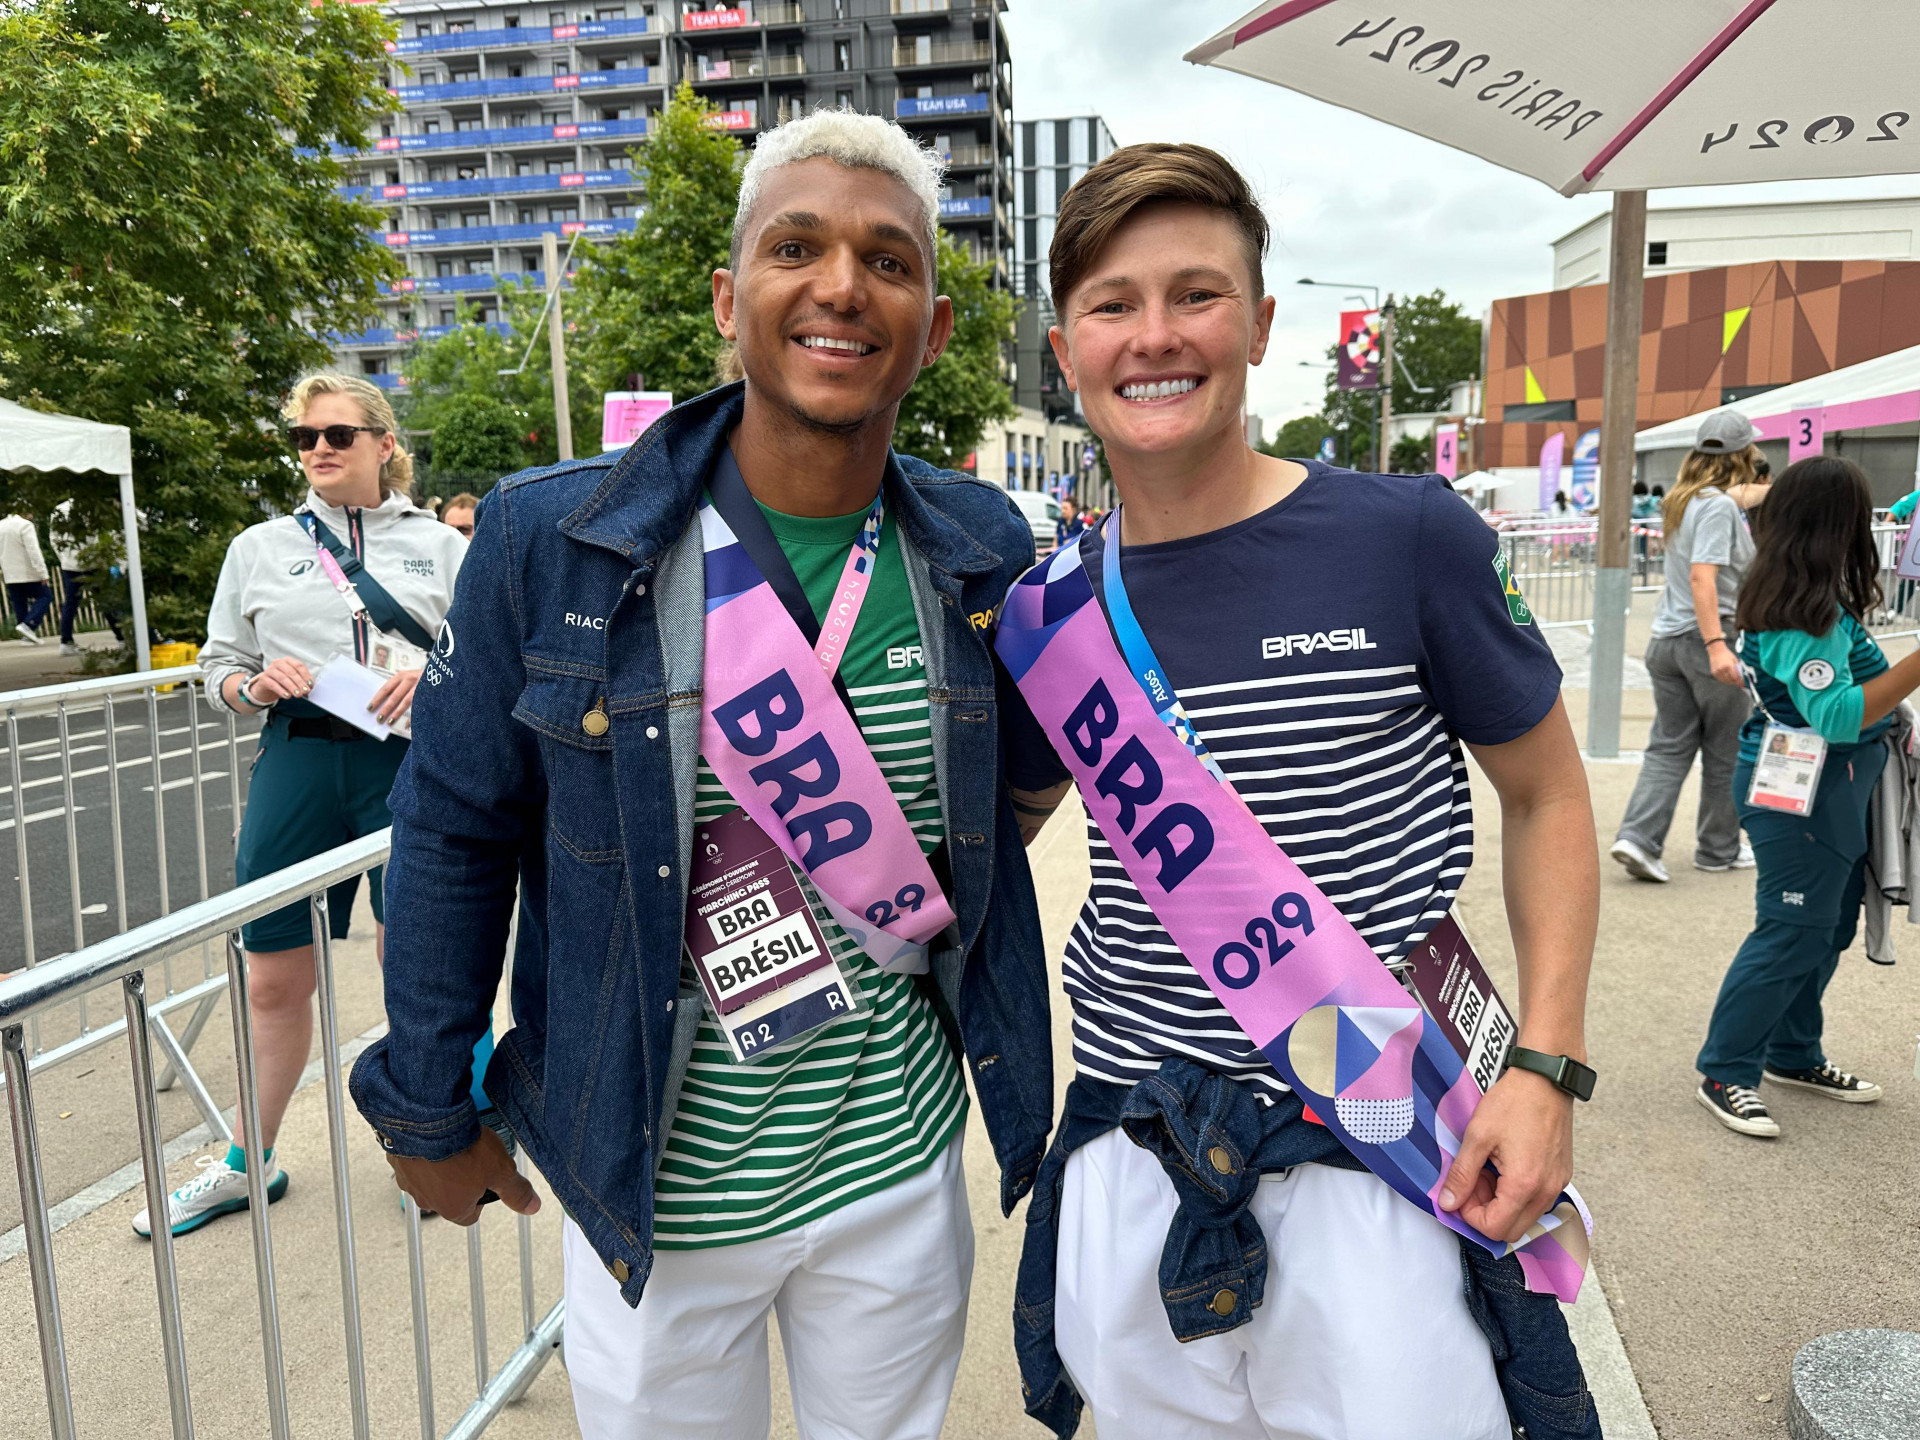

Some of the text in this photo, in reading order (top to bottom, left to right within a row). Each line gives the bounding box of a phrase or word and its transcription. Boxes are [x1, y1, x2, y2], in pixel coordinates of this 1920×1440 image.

[691, 12, 740, 27] TEAM USA
[723, 114, 745, 126] USA
[916, 98, 968, 112] TEAM USA
[948, 201, 970, 212] USA
[1799, 418, 1812, 446] 3
[1441, 440, 1453, 463] 4
[564, 612, 606, 630] RIAC
[820, 580, 861, 670] RIS 2024
[886, 645, 925, 670] BR
[1261, 627, 1378, 660] BRASIL
[1143, 669, 1169, 703] Atos
[711, 667, 873, 875] BRA
[1061, 676, 1215, 894] BRA
[697, 877, 771, 916] MARCHING PASS
[701, 869, 756, 899] OPENING CEREMONY
[717, 897, 772, 938] BRA
[865, 883, 926, 929] 29
[1212, 891, 1316, 990] 029
[711, 930, 814, 993] BRÉSIL
[739, 990, 845, 1051] A 2 R
[1459, 990, 1482, 1038] BRA
[1473, 1012, 1510, 1096] BRÉSIL
